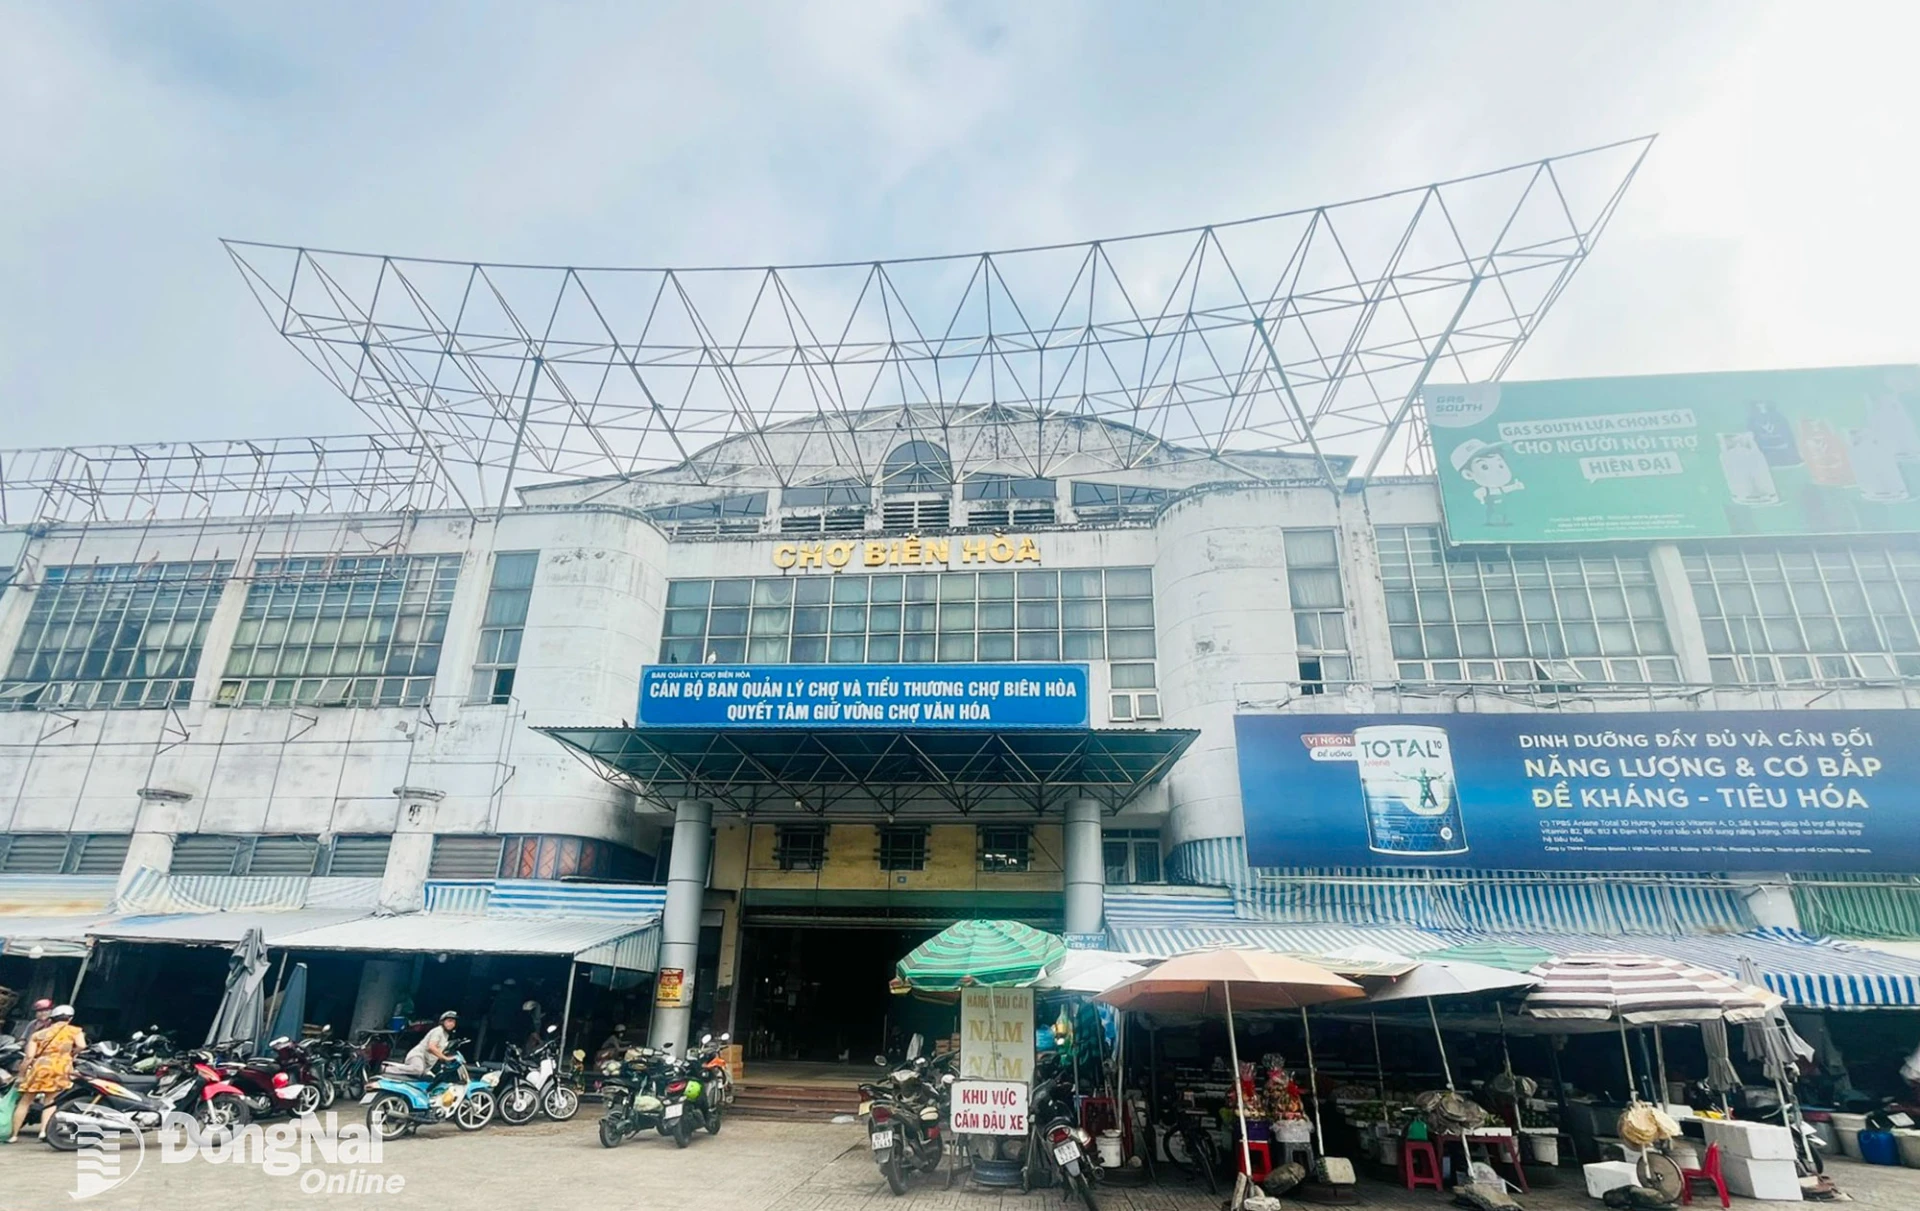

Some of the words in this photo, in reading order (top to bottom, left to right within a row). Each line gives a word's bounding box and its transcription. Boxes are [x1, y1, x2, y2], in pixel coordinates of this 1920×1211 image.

[1436, 396, 1464, 404] GAS
[1436, 404, 1482, 412] SOUTH
[1502, 426, 1531, 436] GAS
[1534, 422, 1582, 434] SOUTH
[1586, 418, 1614, 432] LỰA
[1617, 415, 1658, 430] CHỌN
[1662, 412, 1682, 424] SỐ
[1686, 413, 1692, 424] 1
[1514, 441, 1552, 454] CHO
[1557, 436, 1618, 454] NGƯỜI
[1624, 434, 1656, 454] NỘI
[1659, 434, 1698, 452] TRỢ
[1589, 458, 1634, 476] HIỆN
[1638, 456, 1672, 474] ĐẠI
[773, 541, 856, 574] CHỢ
[864, 534, 949, 567] BIÊN
[962, 528, 1041, 564] HÒA
[668, 670, 688, 679] QUẢN
[690, 670, 699, 679] LÝ
[700, 672, 716, 680] CHỢ
[650, 680, 680, 698] CÁN
[683, 680, 703, 700] BỘ
[707, 682, 738, 698] BAN
[742, 676, 782, 698] QUẢN
[787, 679, 804, 698] LÝ
[808, 680, 840, 700] CHỢ
[843, 679, 862, 697] VÀ
[866, 676, 899, 697] TIỂU
[903, 681, 964, 698] THƯƠNG
[968, 680, 1000, 700] CHỢ
[1004, 679, 1040, 697] BIÊN
[1044, 678, 1076, 697] HÒA
[727, 700, 774, 721] QUYẾT
[777, 702, 809, 720] TÂM
[814, 700, 841, 720] GIỮ
[844, 700, 884, 720] VỮNG
[888, 703, 920, 724] CHỢ
[924, 701, 955, 720] VĂN
[959, 701, 990, 720] HÓA
[1307, 736, 1318, 746] VỊ
[1320, 736, 1352, 745] NGON
[1519, 734, 1568, 748] DINH
[1574, 731, 1649, 748] DƯỠNG
[1655, 728, 1698, 748] ĐẦY
[1706, 728, 1737, 747] ĐỦ
[1742, 730, 1773, 746] VÀ
[1778, 729, 1826, 746] CÂN
[1832, 727, 1873, 746] ĐỐI
[1330, 750, 1352, 758] UỐNG
[1361, 739, 1440, 759] TOTAL
[1434, 740, 1442, 750] 10
[1524, 754, 1611, 778] NĂNG
[1618, 756, 1726, 783] LƯỢNG
[1736, 757, 1756, 777] &
[1764, 755, 1809, 777] CƠ
[1817, 748, 1882, 777] BẮP
[1532, 780, 1573, 808] ĐỀ
[1580, 783, 1690, 808] KHÁNG
[1716, 783, 1788, 808] TIÊU
[1797, 783, 1869, 808] HÓA
[962, 1089, 988, 1105] KHU
[992, 1088, 1016, 1108] VỰC
[954, 1108, 979, 1129] CẤM
[983, 1110, 1006, 1132] ĐẬU
[1010, 1115, 1024, 1130] XE
